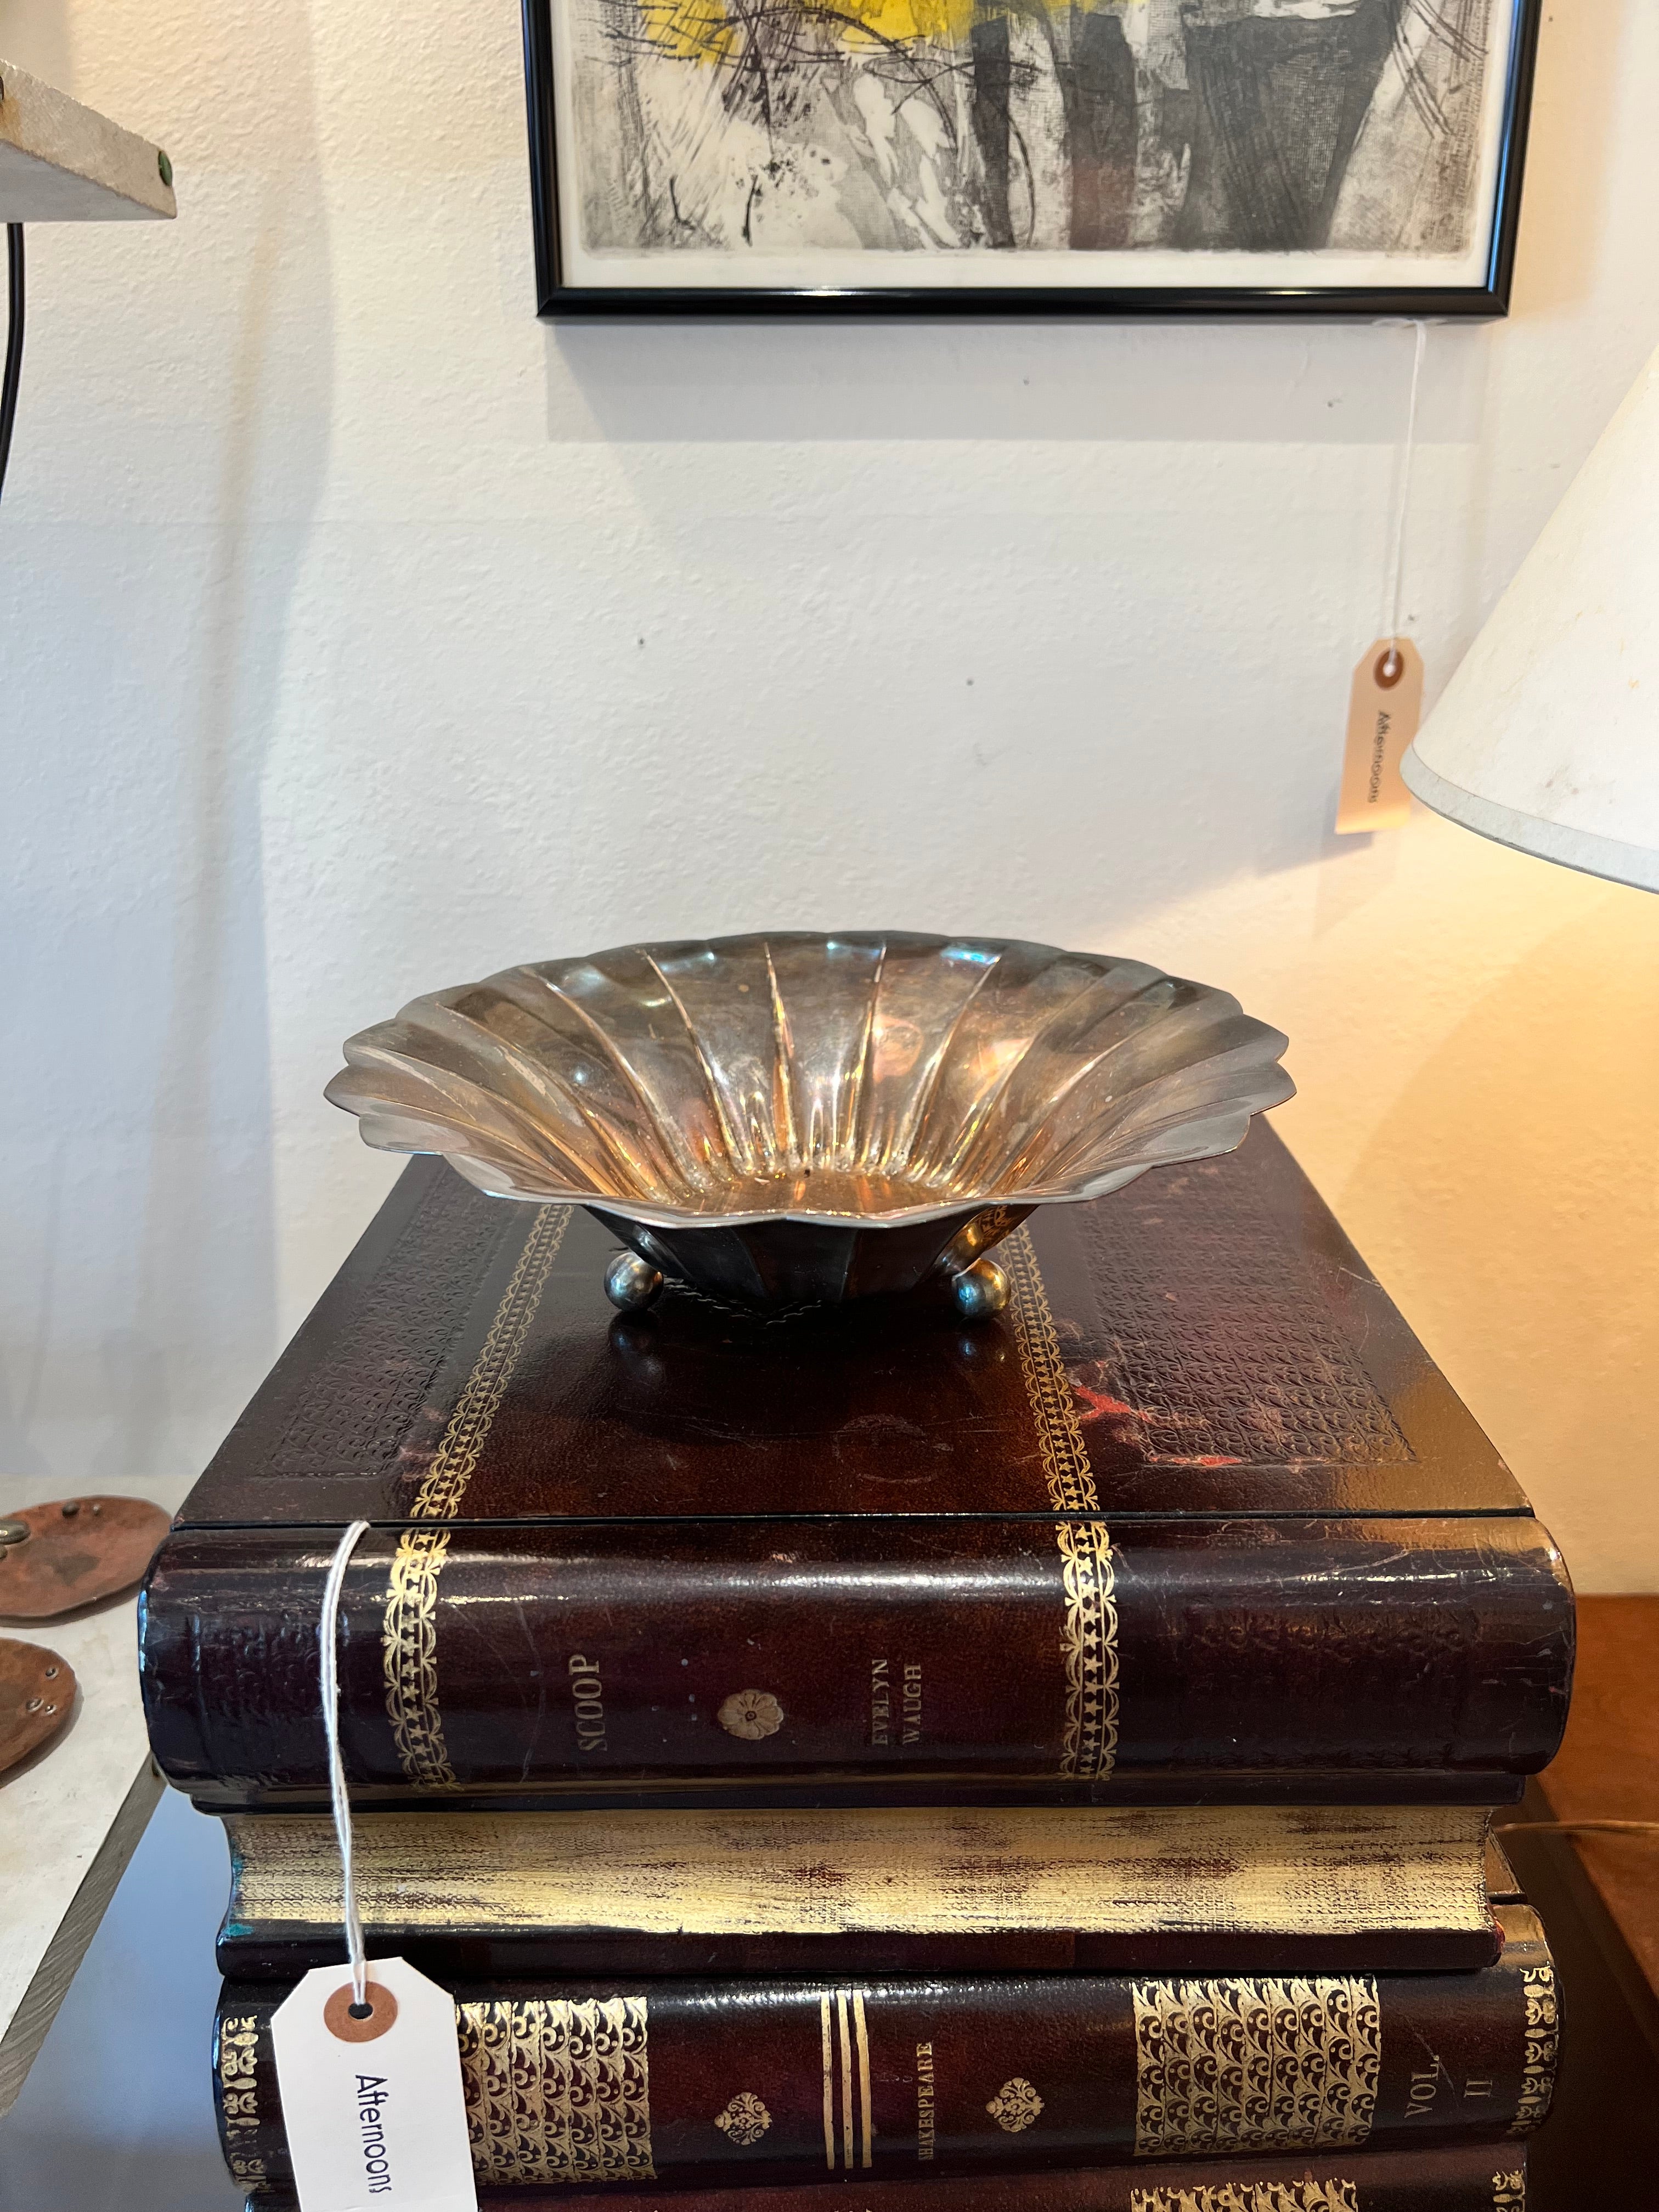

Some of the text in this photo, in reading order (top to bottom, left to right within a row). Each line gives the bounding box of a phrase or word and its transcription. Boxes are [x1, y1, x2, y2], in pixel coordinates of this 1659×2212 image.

[568, 1654, 607, 1751] SCOOP
[872, 1659, 889, 1745] EVELYN
[902, 1663, 922, 1745] WAUGH
[356, 2074, 393, 2194] Afternoons
[916, 2041, 934, 2160] SHAKESPEARE
[1463, 2079, 1493, 2098] II
